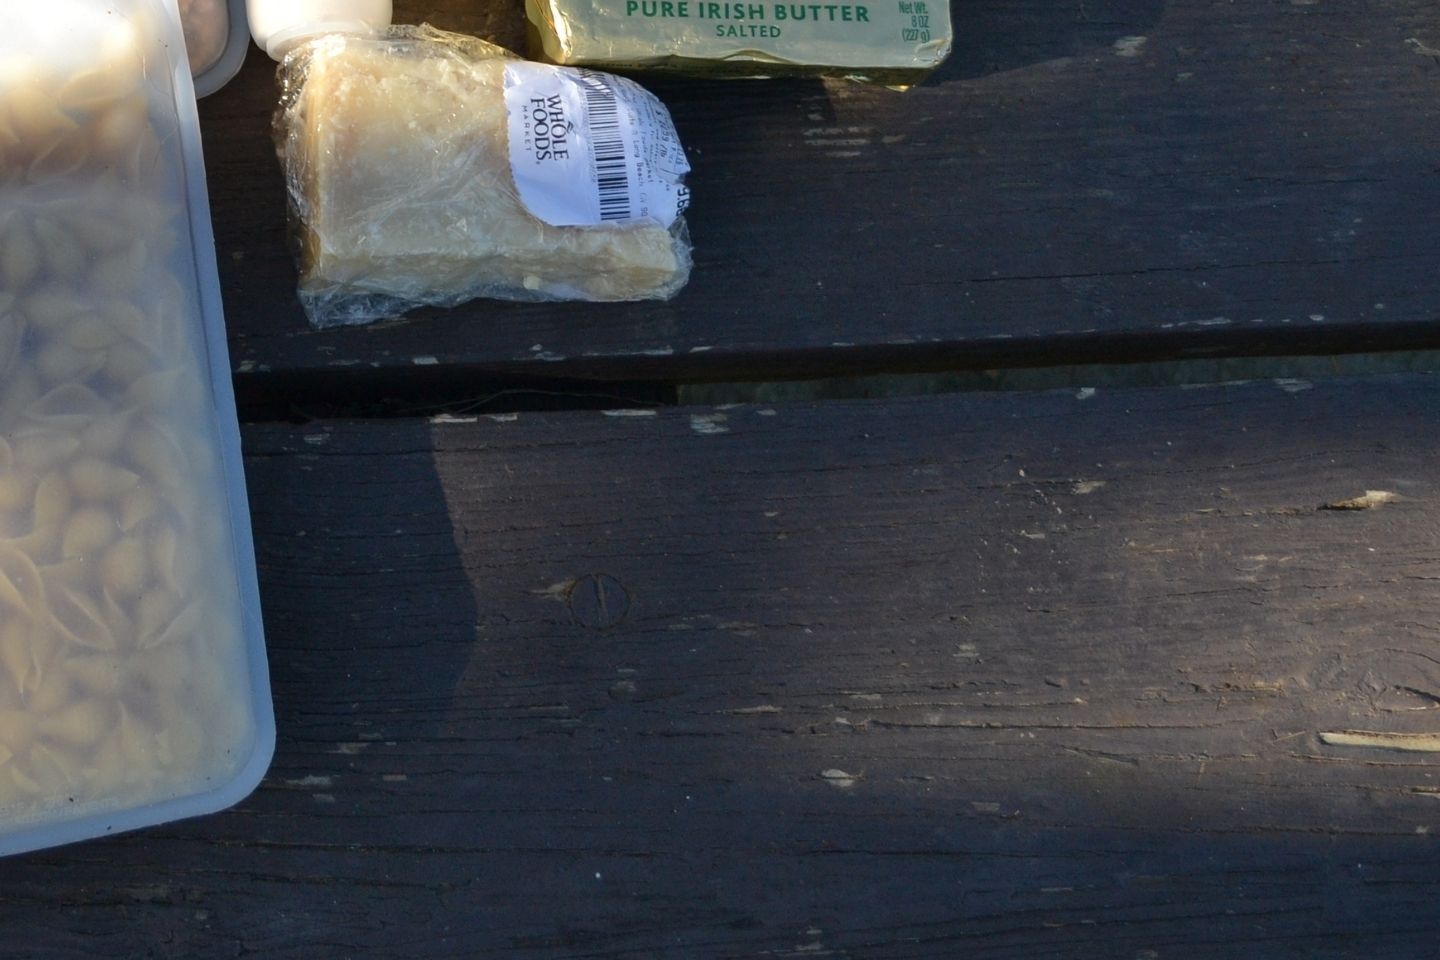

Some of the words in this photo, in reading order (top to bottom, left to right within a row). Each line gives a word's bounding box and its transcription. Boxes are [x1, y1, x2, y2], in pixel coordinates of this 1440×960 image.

[626, 0, 689, 18] PURE
[699, 1, 764, 21] IRISH
[775, 4, 870, 22] BUTTER
[898, 1, 913, 14] Net
[914, 1, 929, 14] Wt.
[716, 24, 782, 39] SALTED
[911, 16, 918, 28] 8
[919, 16, 930, 29] OZ
[902, 29, 919, 42] (227
[920, 31, 931, 43] g)
[522, 105, 532, 151] MARKET
[530, 98, 552, 161] FOODS
[547, 94, 570, 161] WHOLE
